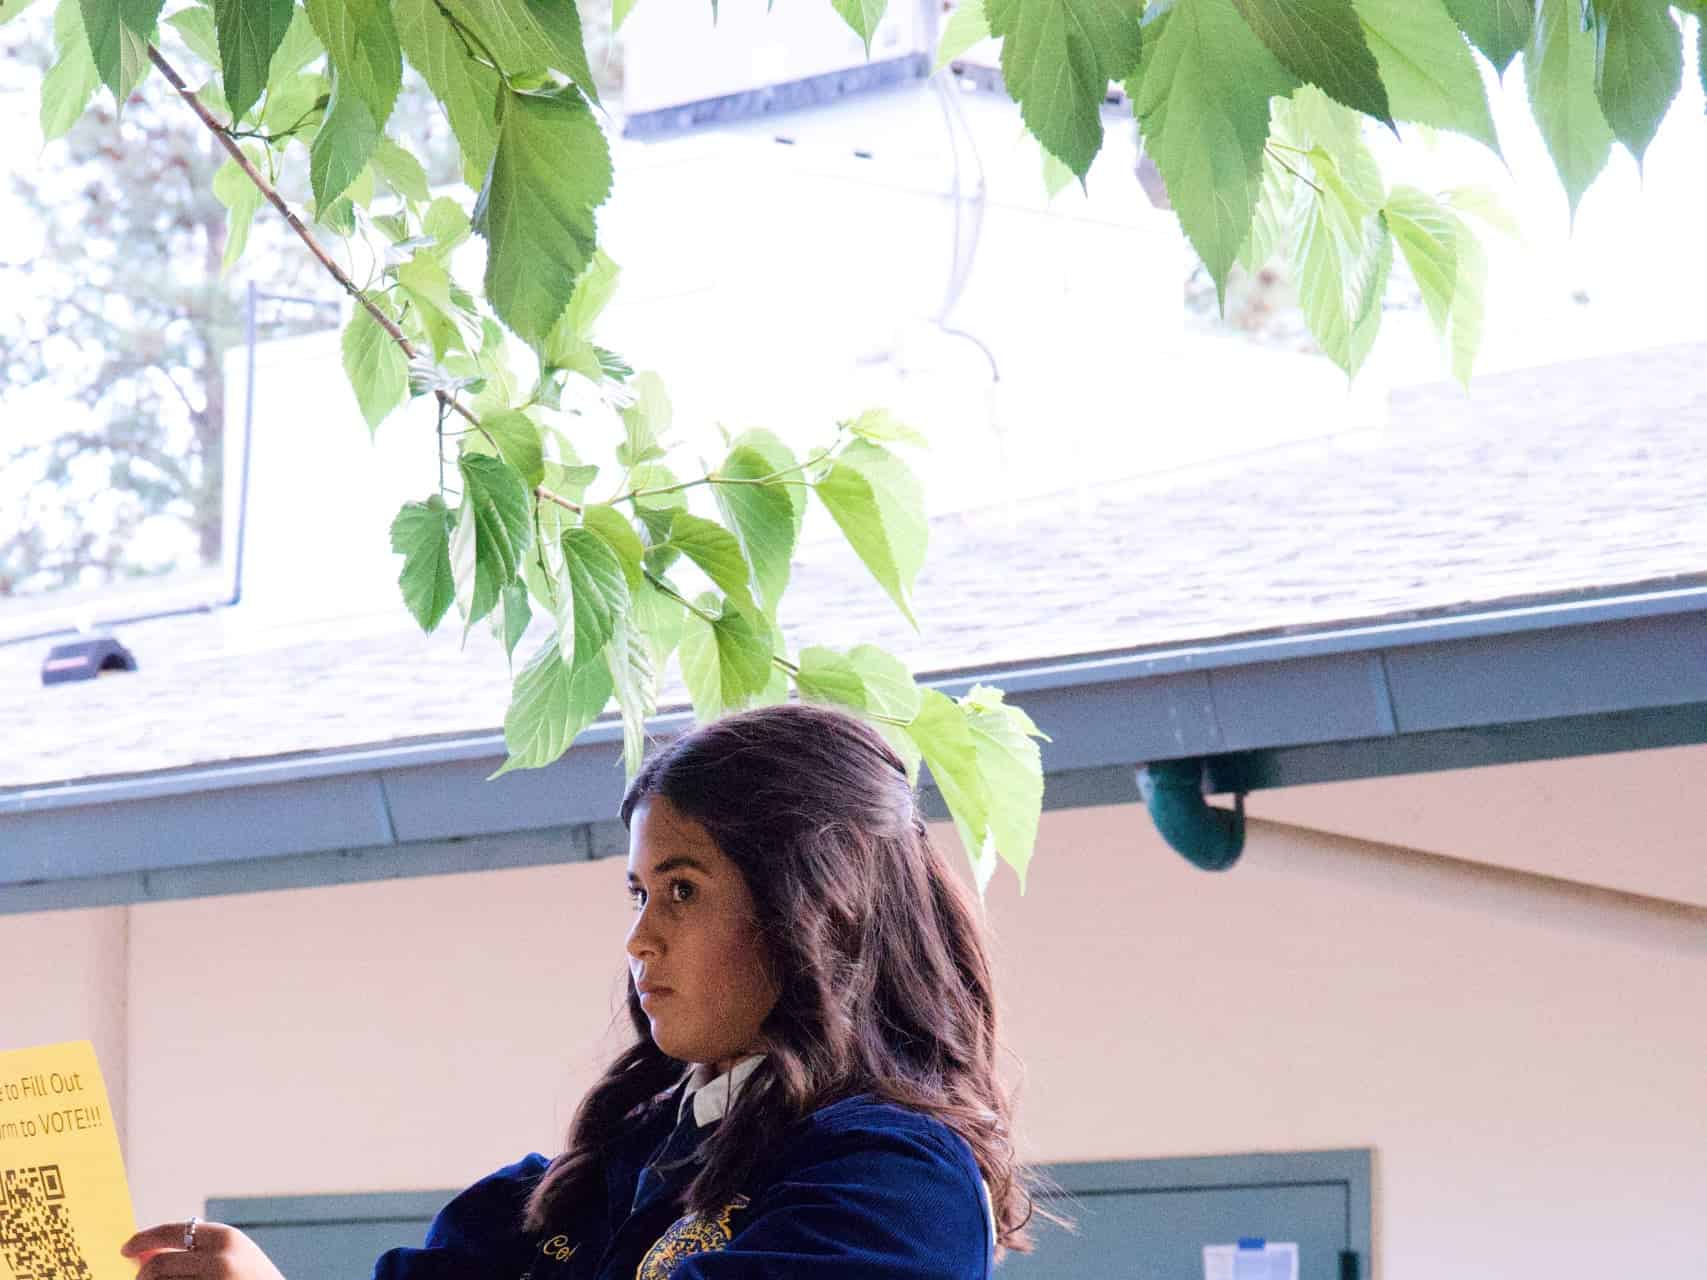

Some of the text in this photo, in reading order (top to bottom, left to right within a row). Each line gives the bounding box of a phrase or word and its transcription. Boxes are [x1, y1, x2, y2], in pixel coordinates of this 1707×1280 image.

[5, 1083, 19, 1101] to
[20, 1075, 48, 1097] Fill
[50, 1072, 83, 1094] Out
[0, 1105, 103, 1140] rm to VOTE!!!
